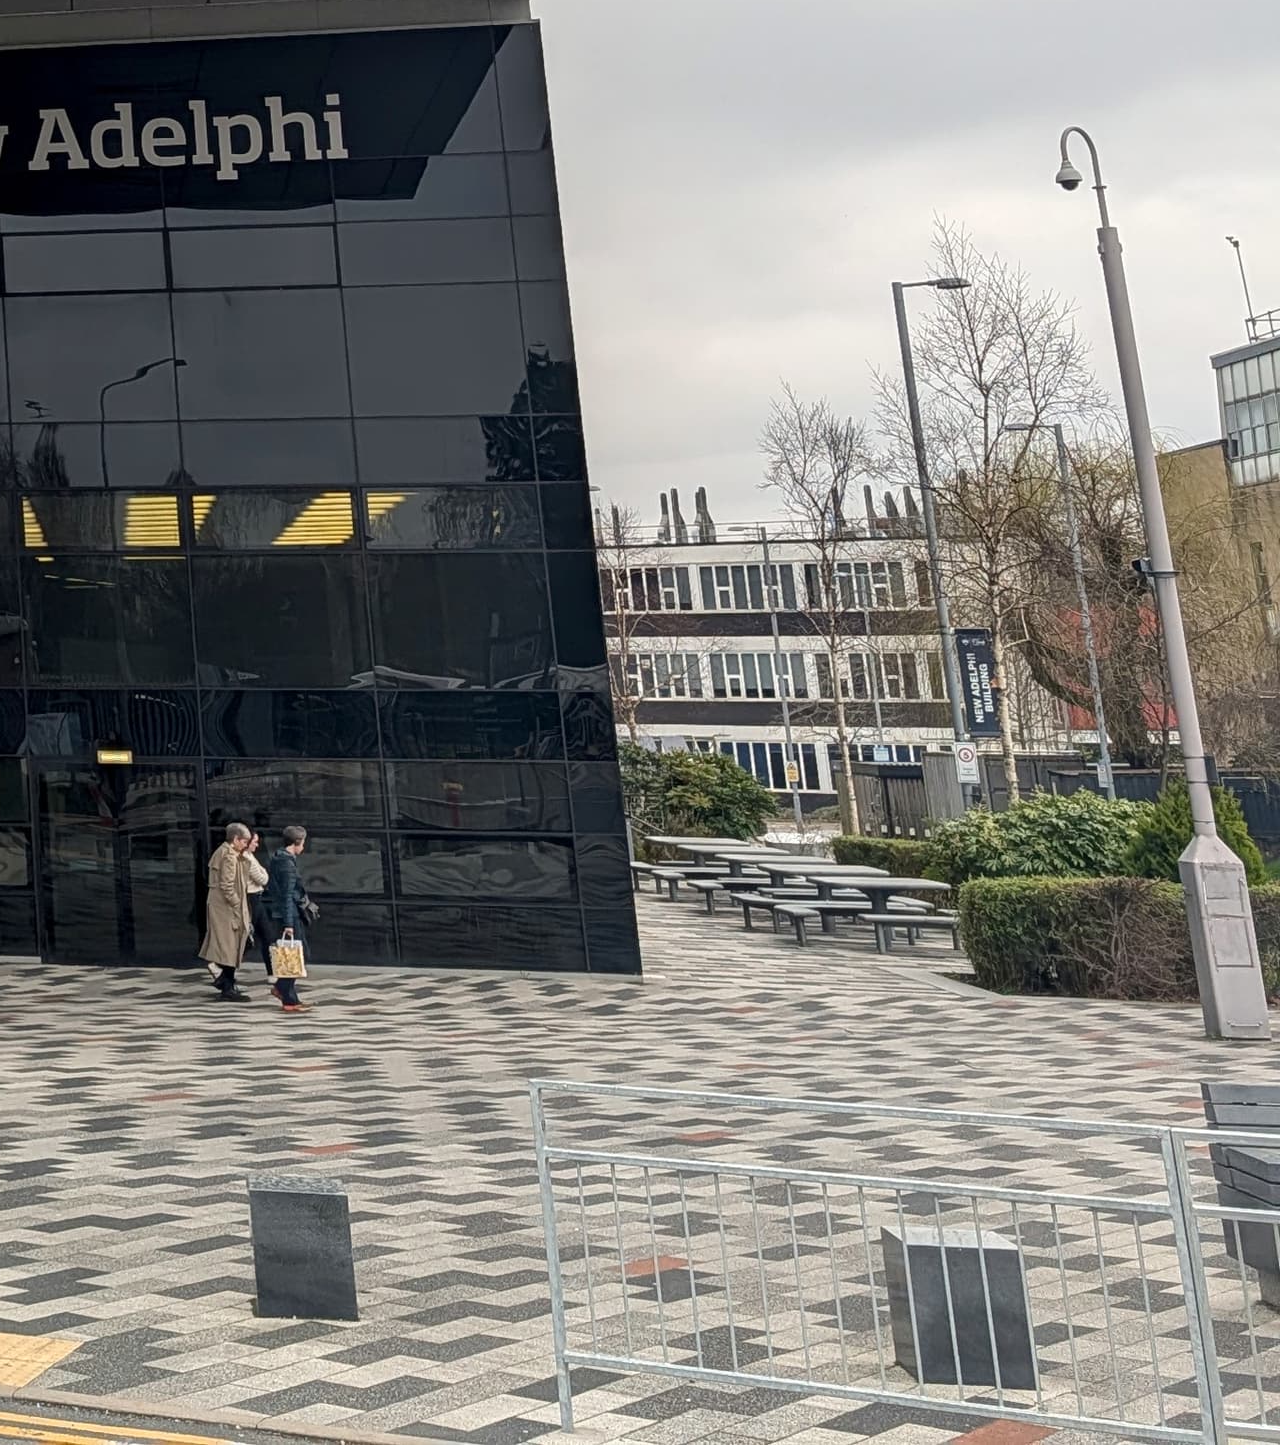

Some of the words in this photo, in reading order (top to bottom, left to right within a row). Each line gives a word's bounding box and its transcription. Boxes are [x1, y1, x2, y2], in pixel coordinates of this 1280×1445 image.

[28, 93, 349, 181] Adelphi
[966, 652, 981, 697] ADELPHI
[979, 663, 994, 713] BUILDING
[973, 698, 985, 723] NEW
